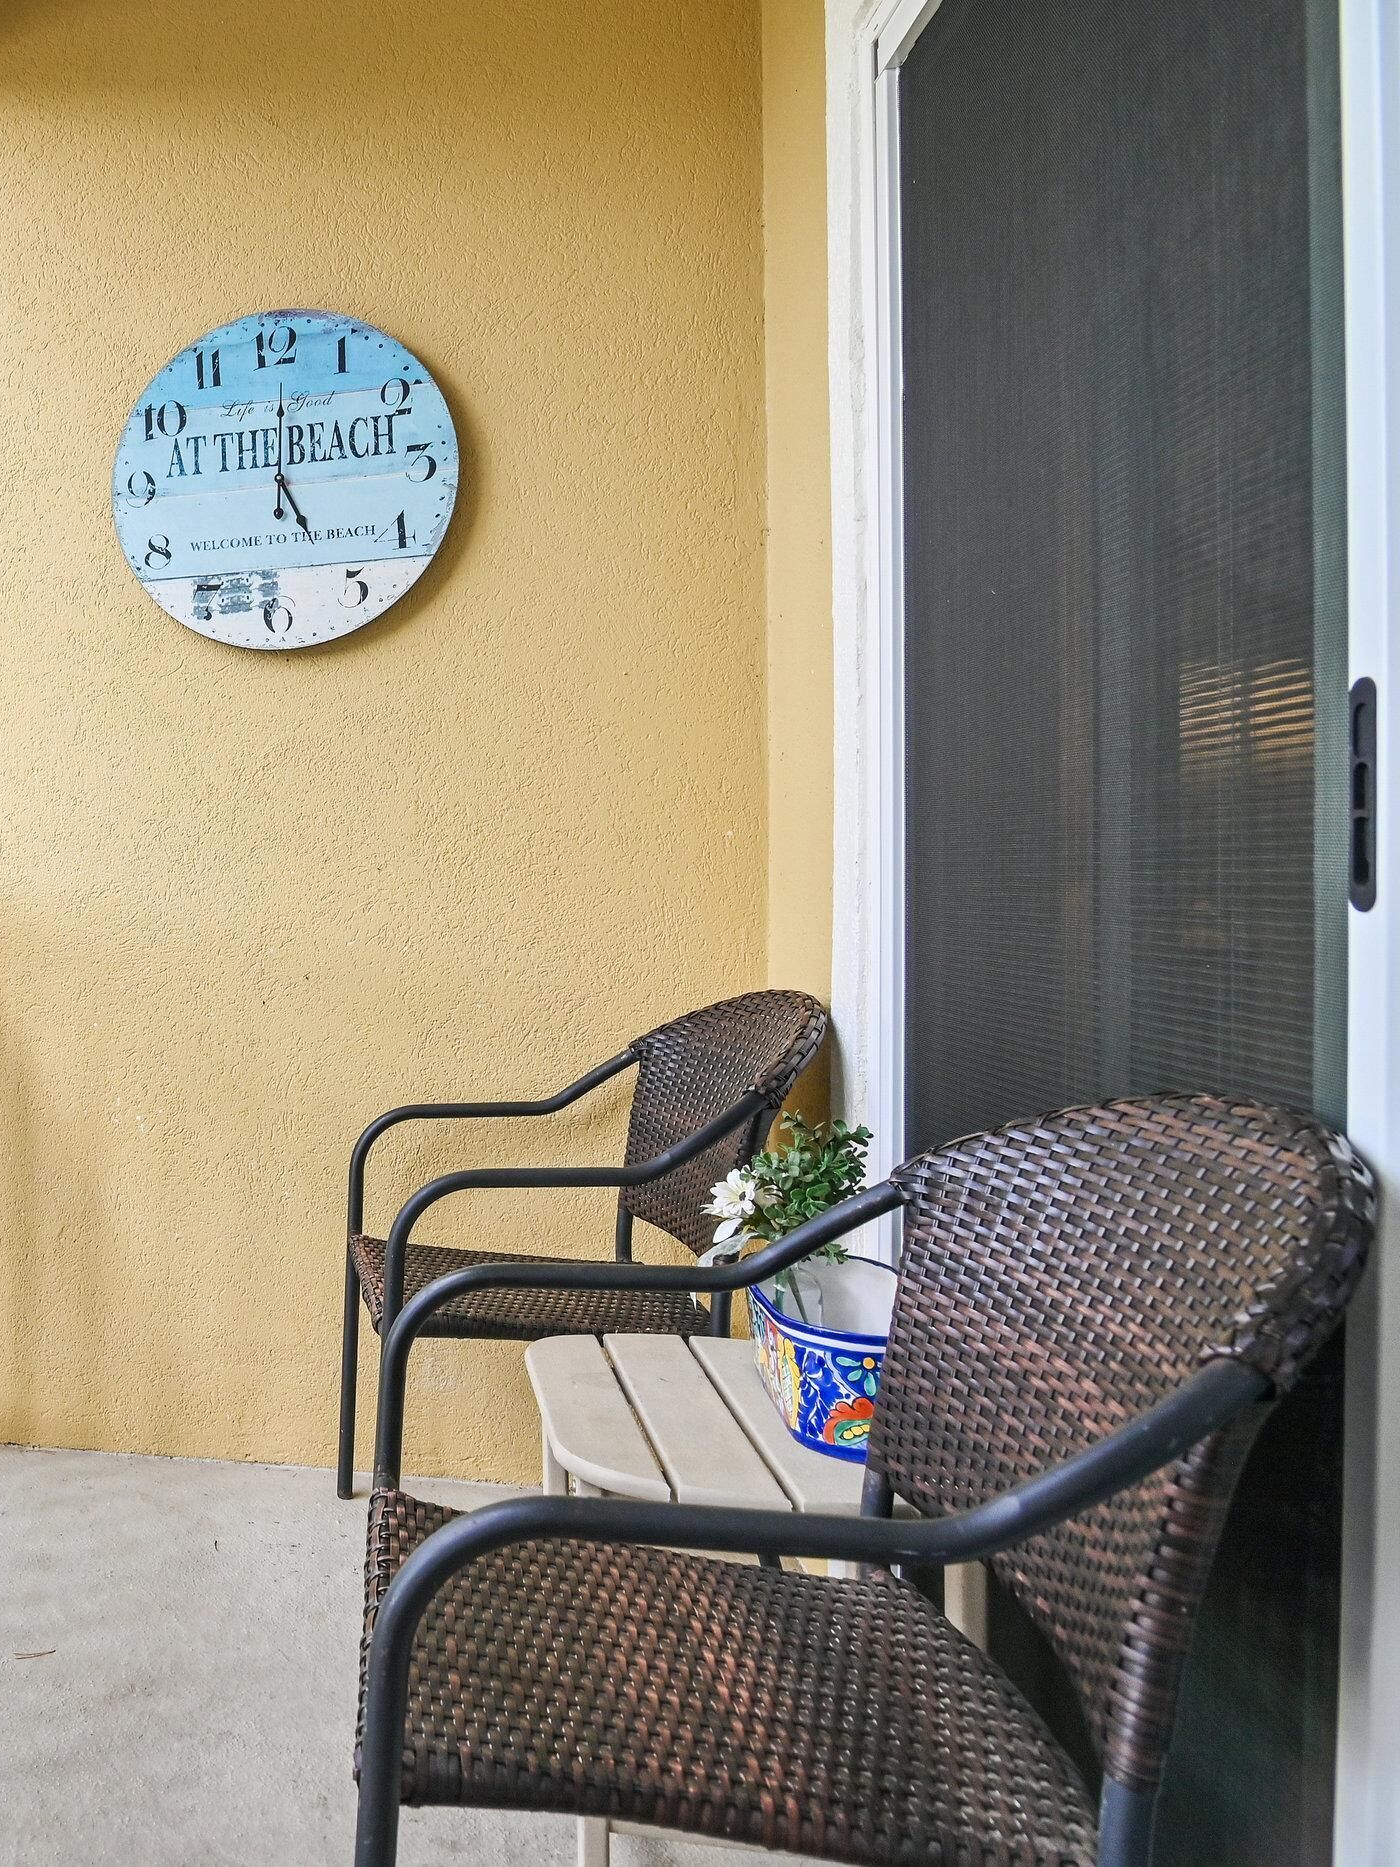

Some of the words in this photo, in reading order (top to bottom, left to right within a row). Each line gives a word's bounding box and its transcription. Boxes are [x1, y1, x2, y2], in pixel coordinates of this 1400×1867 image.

[251, 325, 297, 371] 12
[333, 335, 350, 374] 1
[194, 347, 222, 390] 11
[220, 400, 255, 421] Life
[264, 400, 275, 412] is
[287, 390, 335, 412] Good
[380, 377, 412, 417] 2
[143, 400, 188, 442] 10
[166, 436, 207, 478] AT
[213, 427, 280, 472] THE
[286, 414, 396, 465] BEACH
[404, 442, 437, 482] 3
[126, 471, 156, 508] 9
[190, 535, 263, 552] WELCOME
[265, 533, 287, 545] TO
[291, 530, 322, 543] THE
[327, 524, 376, 540] BEACH
[374, 509, 416, 550] 4
[144, 534, 172, 570] 8
[193, 582, 223, 621] 7
[337, 566, 369, 608] 5
[263, 596, 297, 634] 6
